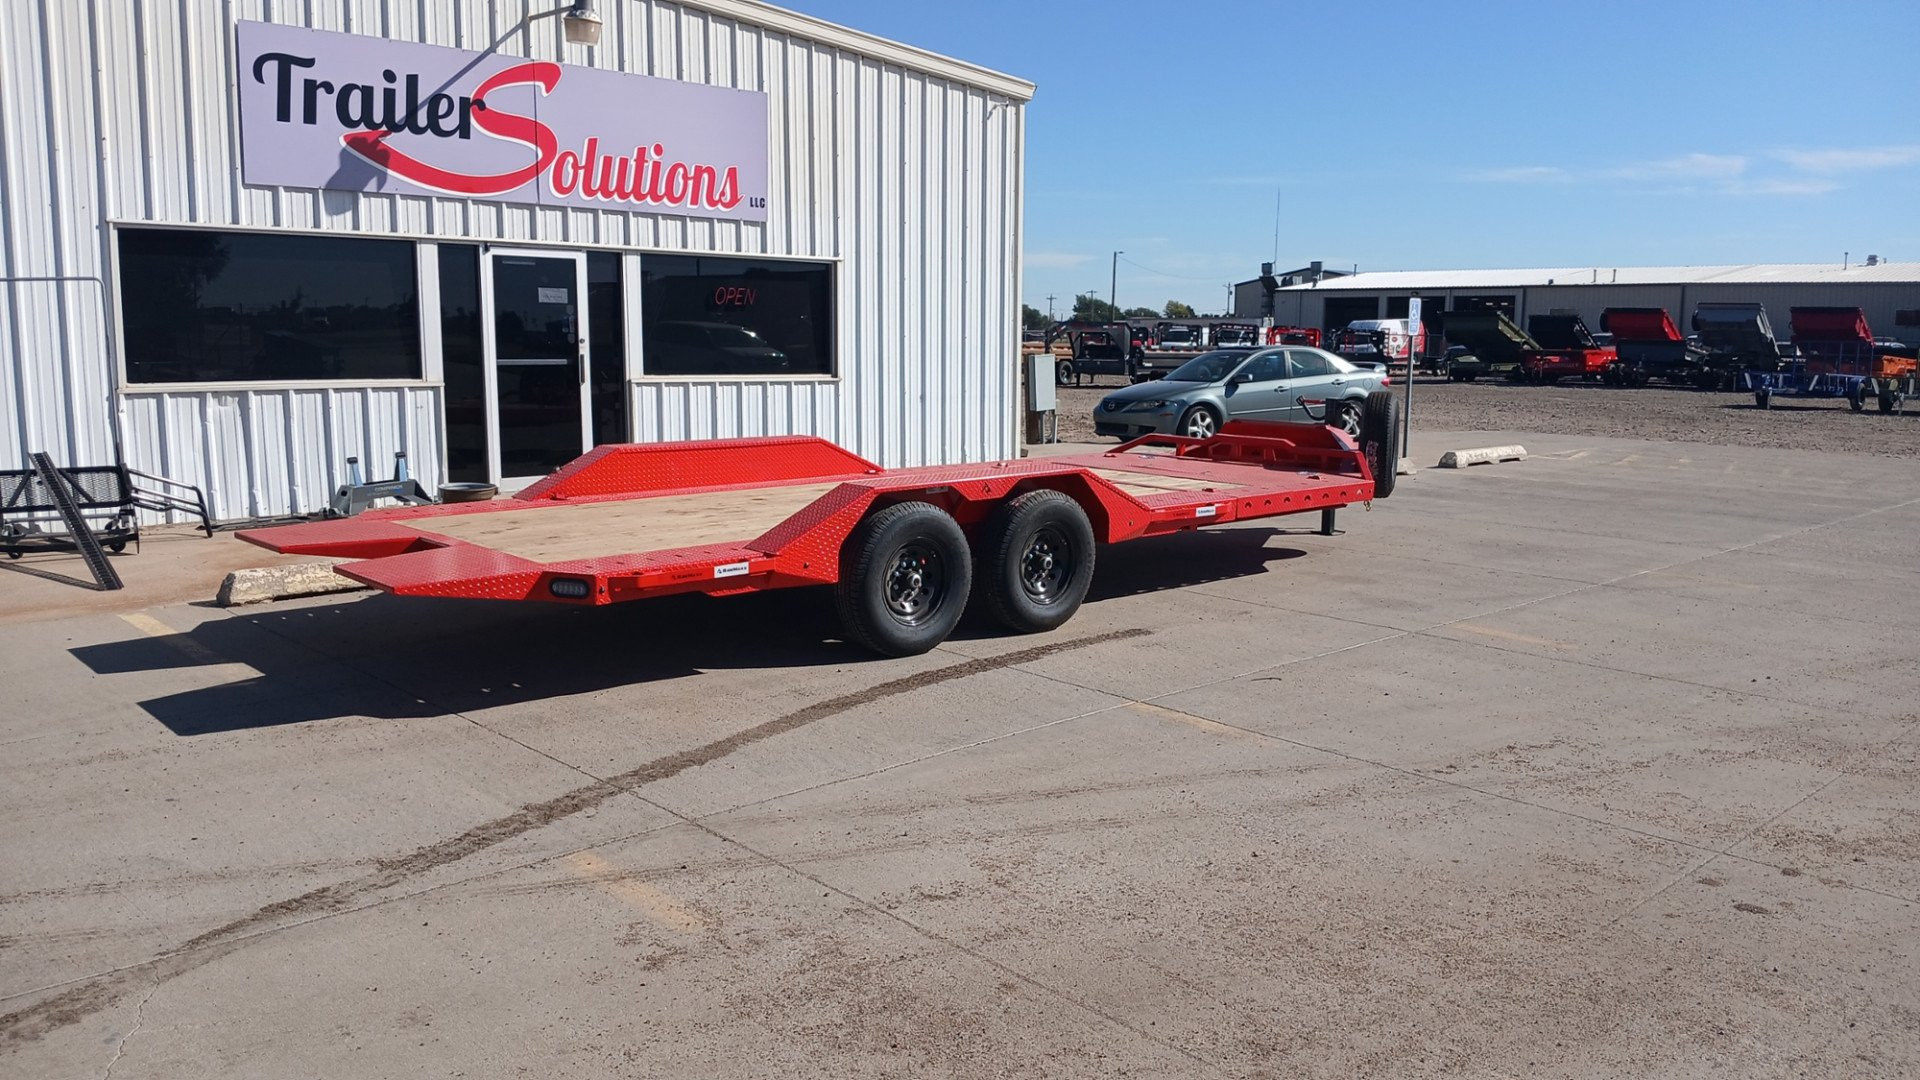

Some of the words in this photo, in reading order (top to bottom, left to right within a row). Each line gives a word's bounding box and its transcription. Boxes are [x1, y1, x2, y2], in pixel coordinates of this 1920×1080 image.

[252, 52, 487, 140] Trailer
[339, 61, 746, 212] Solutions
[749, 196, 766, 209] LLC
[715, 286, 757, 305] OPEN
